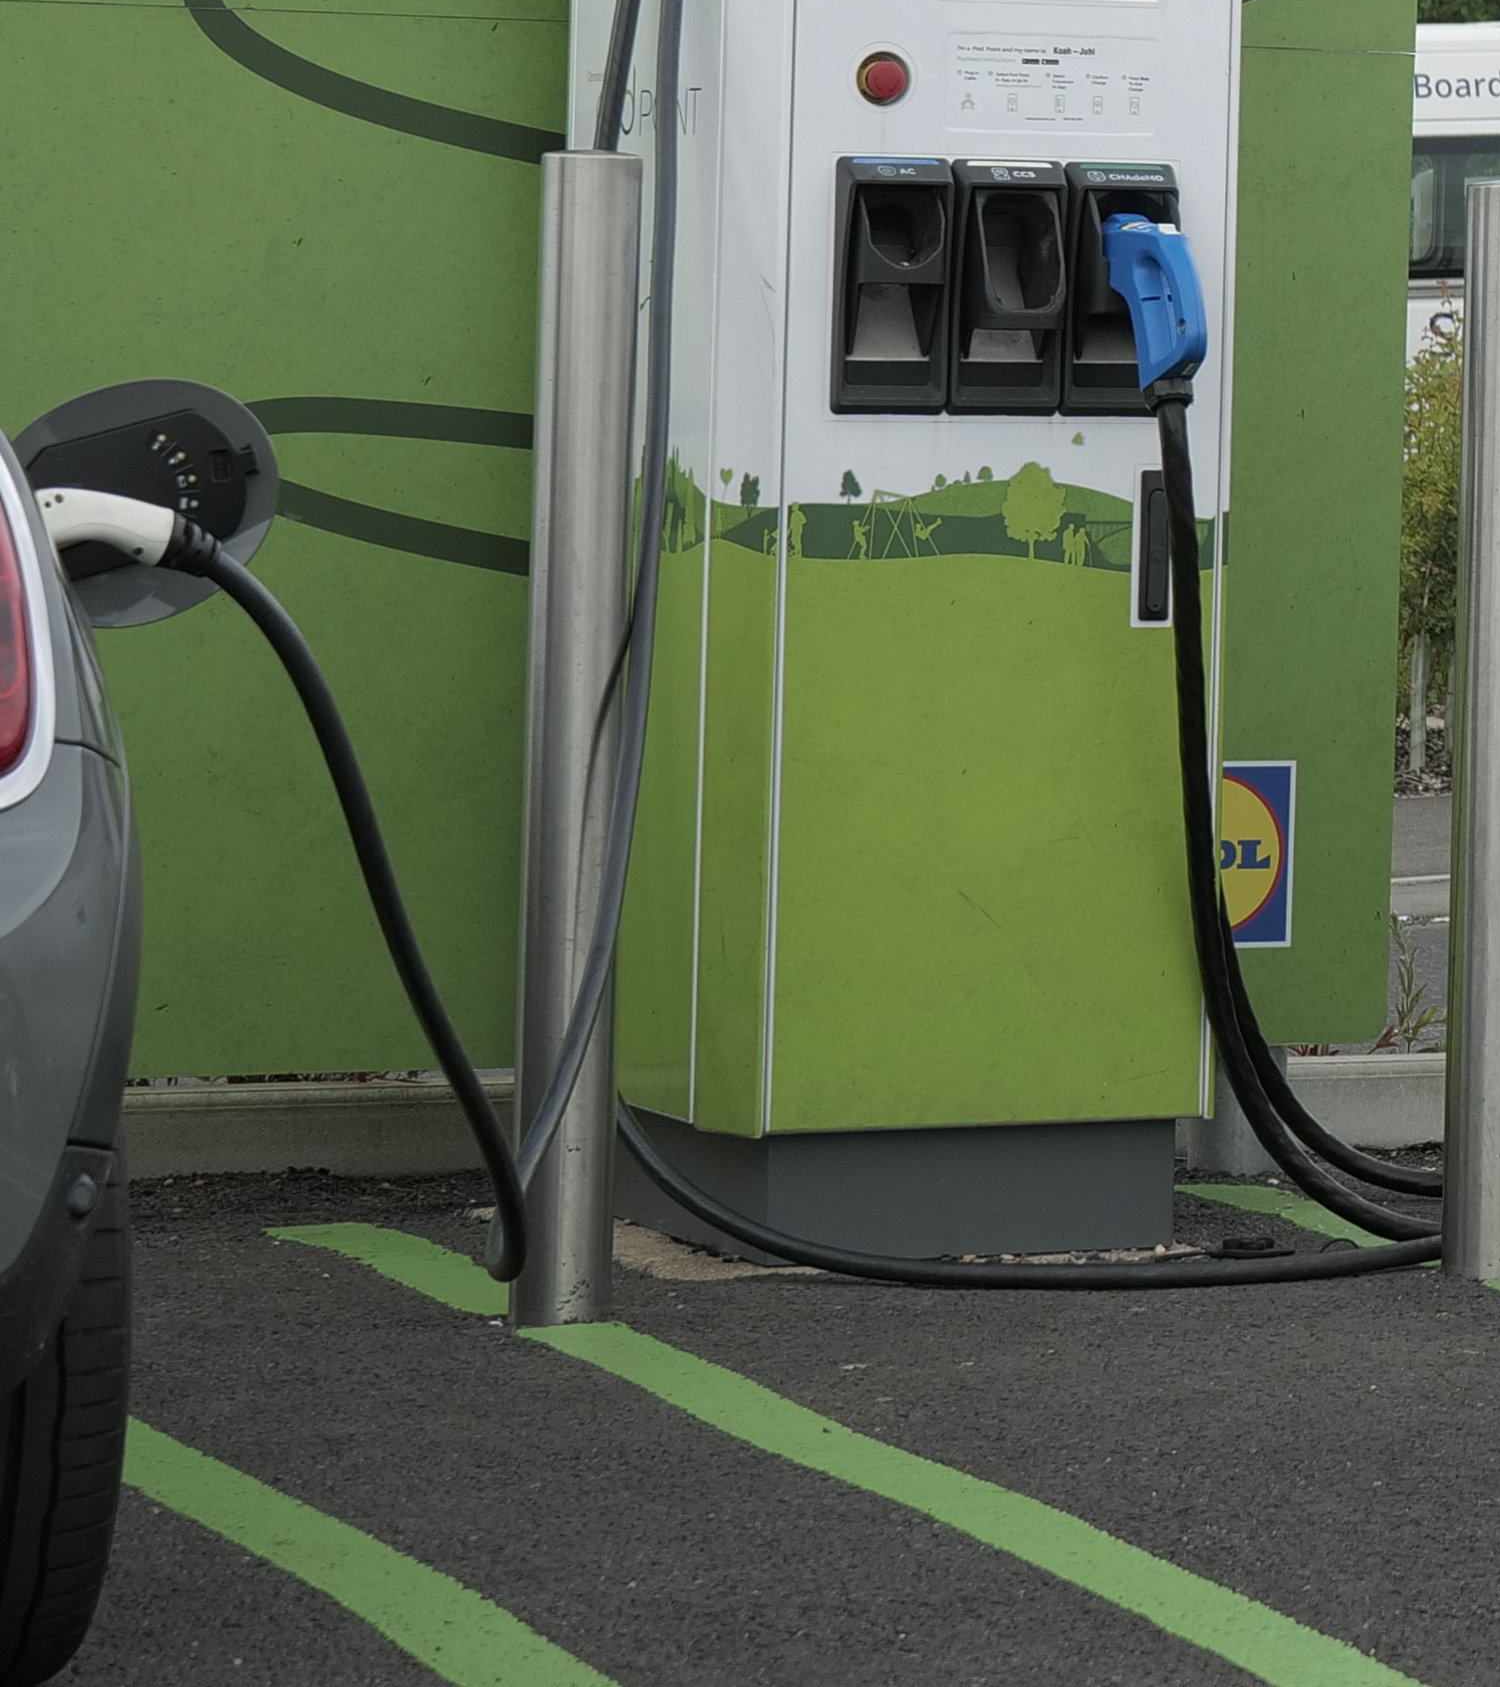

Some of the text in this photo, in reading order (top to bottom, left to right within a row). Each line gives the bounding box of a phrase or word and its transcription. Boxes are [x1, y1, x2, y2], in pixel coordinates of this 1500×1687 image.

[900, 167, 916, 176] AC
[1012, 170, 1037, 180] CCS
[1108, 171, 1164, 184] CHAdeMO
